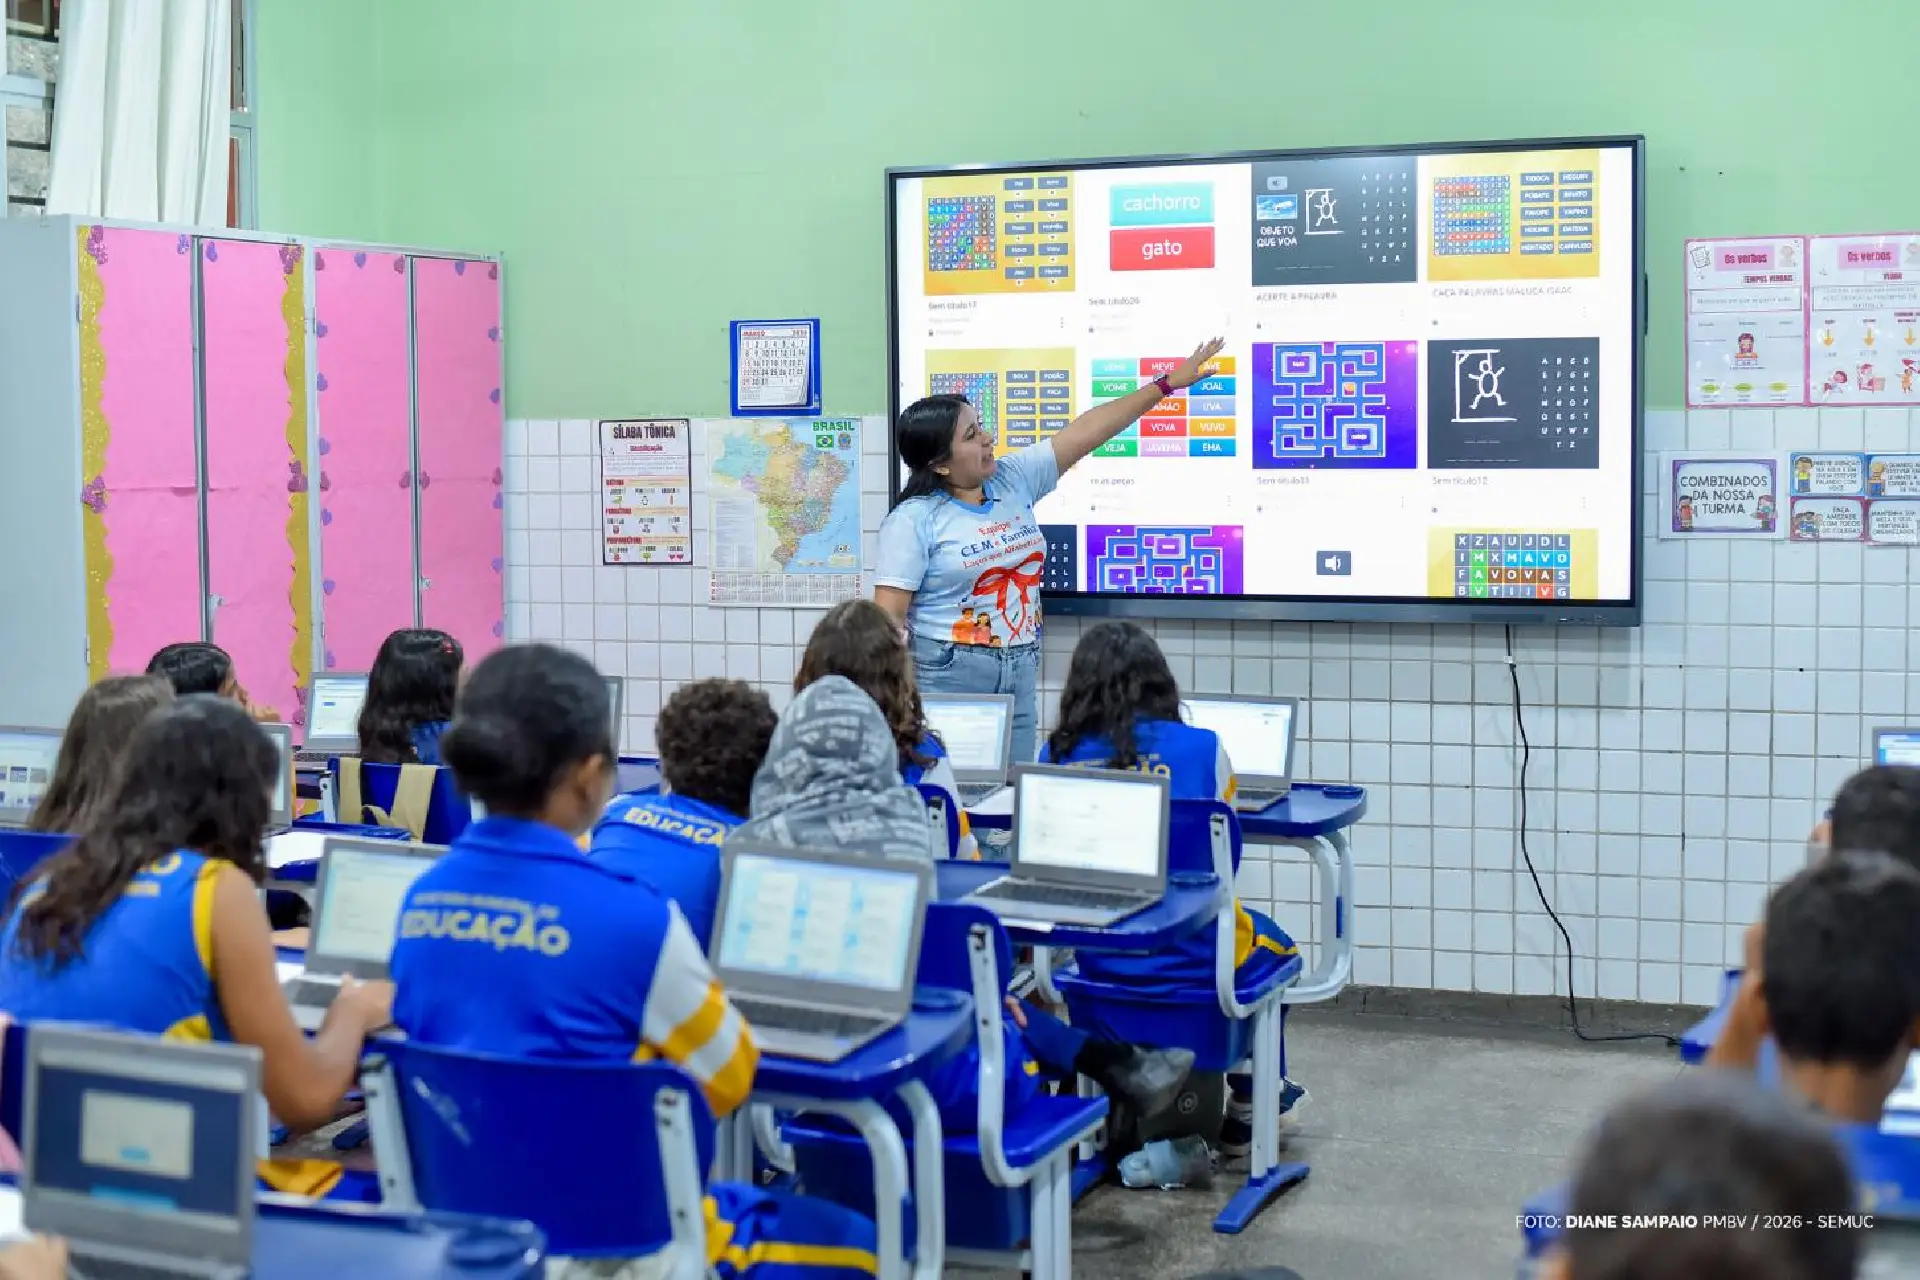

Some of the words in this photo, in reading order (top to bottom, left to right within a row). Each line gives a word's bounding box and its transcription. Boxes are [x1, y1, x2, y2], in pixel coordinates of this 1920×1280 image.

[1123, 192, 1201, 212] cachorro
[1259, 225, 1295, 236] OBJETO
[1256, 238, 1276, 248] QUE
[1278, 237, 1298, 247] VOA
[1142, 239, 1183, 260] gato
[1202, 401, 1222, 411] UVA
[613, 423, 643, 439] SÍLABA
[644, 422, 676, 439] TÔNICA
[812, 421, 855, 431] BRASIL
[1151, 422, 1176, 432] VOVA
[1680, 475, 1767, 488] COMBINADOS
[1692, 490, 1709, 501] DA
[1712, 489, 1755, 501] NOSSA
[1702, 503, 1746, 515] TURMA
[624, 806, 725, 848] EDUCAÇÃ
[401, 904, 571, 957] EDUCAÇÃO
